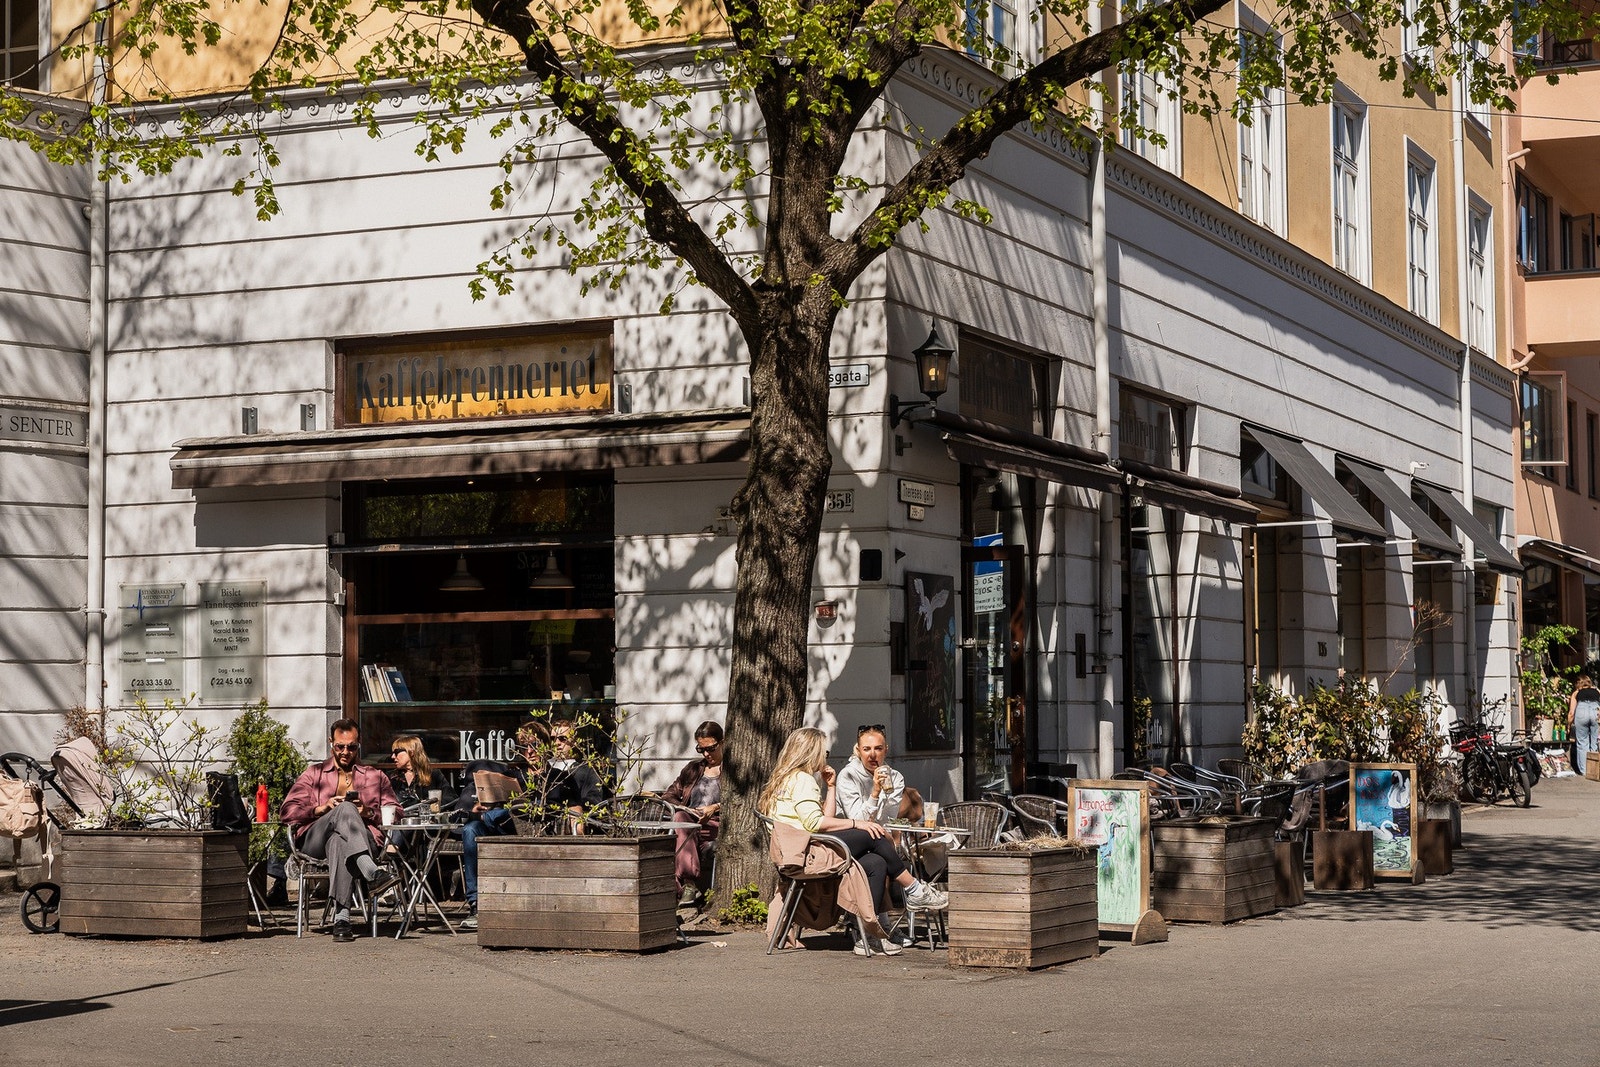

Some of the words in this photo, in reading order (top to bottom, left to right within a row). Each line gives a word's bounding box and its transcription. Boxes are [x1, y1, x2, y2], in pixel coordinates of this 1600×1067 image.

[354, 346, 601, 409] Kaffebrenneriet
[9, 415, 75, 437] SENTER
[828, 493, 851, 509] 35B
[221, 588, 241, 598] Bislet
[203, 600, 259, 610] Tannlegesenter
[136, 679, 145, 687] 23
[163, 678, 173, 686] 80
[459, 730, 516, 761] Kaffe
